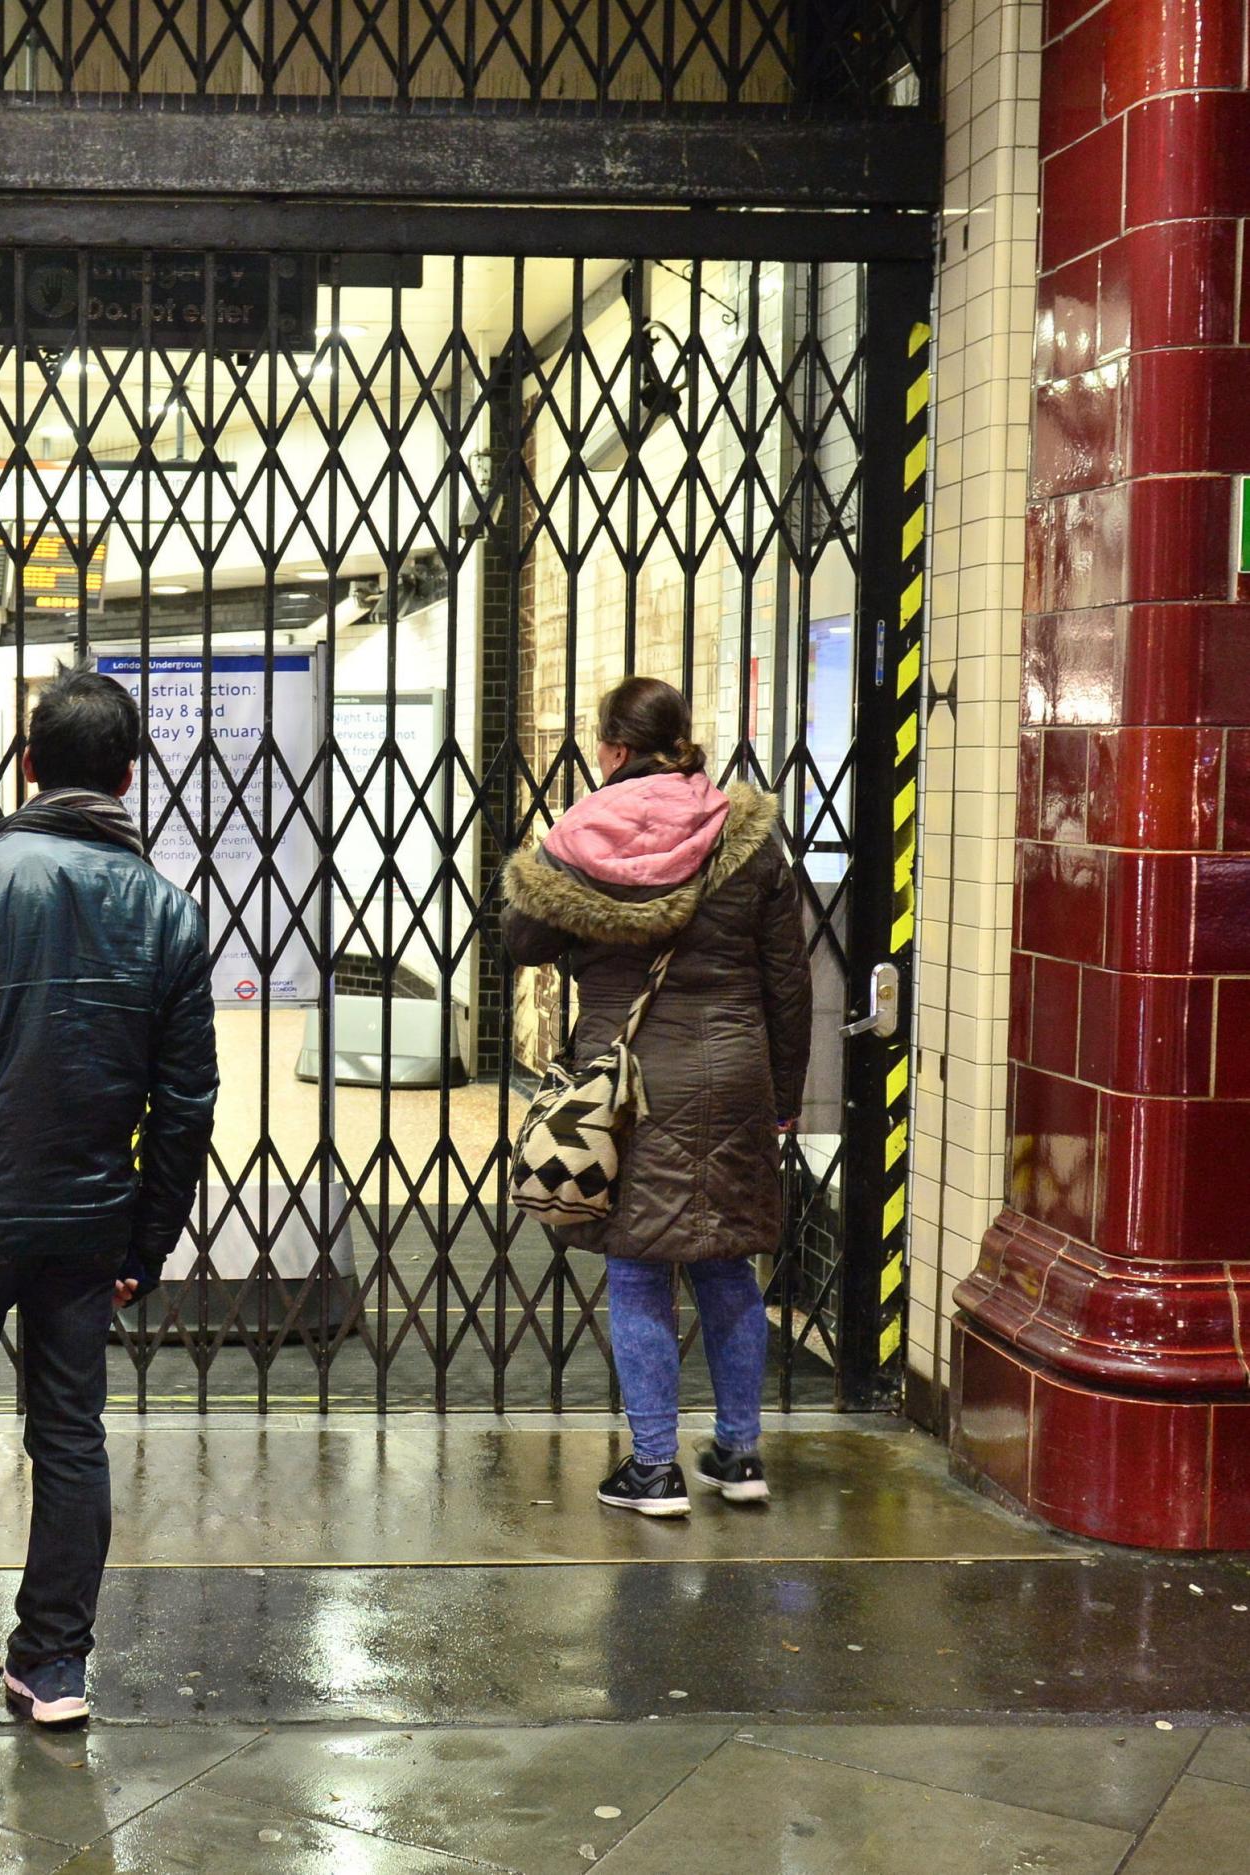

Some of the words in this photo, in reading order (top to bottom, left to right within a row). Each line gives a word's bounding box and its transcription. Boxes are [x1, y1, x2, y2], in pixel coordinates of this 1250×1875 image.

[113, 661, 141, 669] Londo
[148, 661, 202, 670] Undergroun
[129, 684, 194, 697] dstrial
[180, 704, 189, 718] 8
[194, 703, 225, 718] ad
[366, 712, 387, 723] Tub
[185, 725, 195, 739] 9
[210, 727, 265, 742] anuary
[335, 731, 375, 740] ervices
[153, 850, 198, 862] Monday
